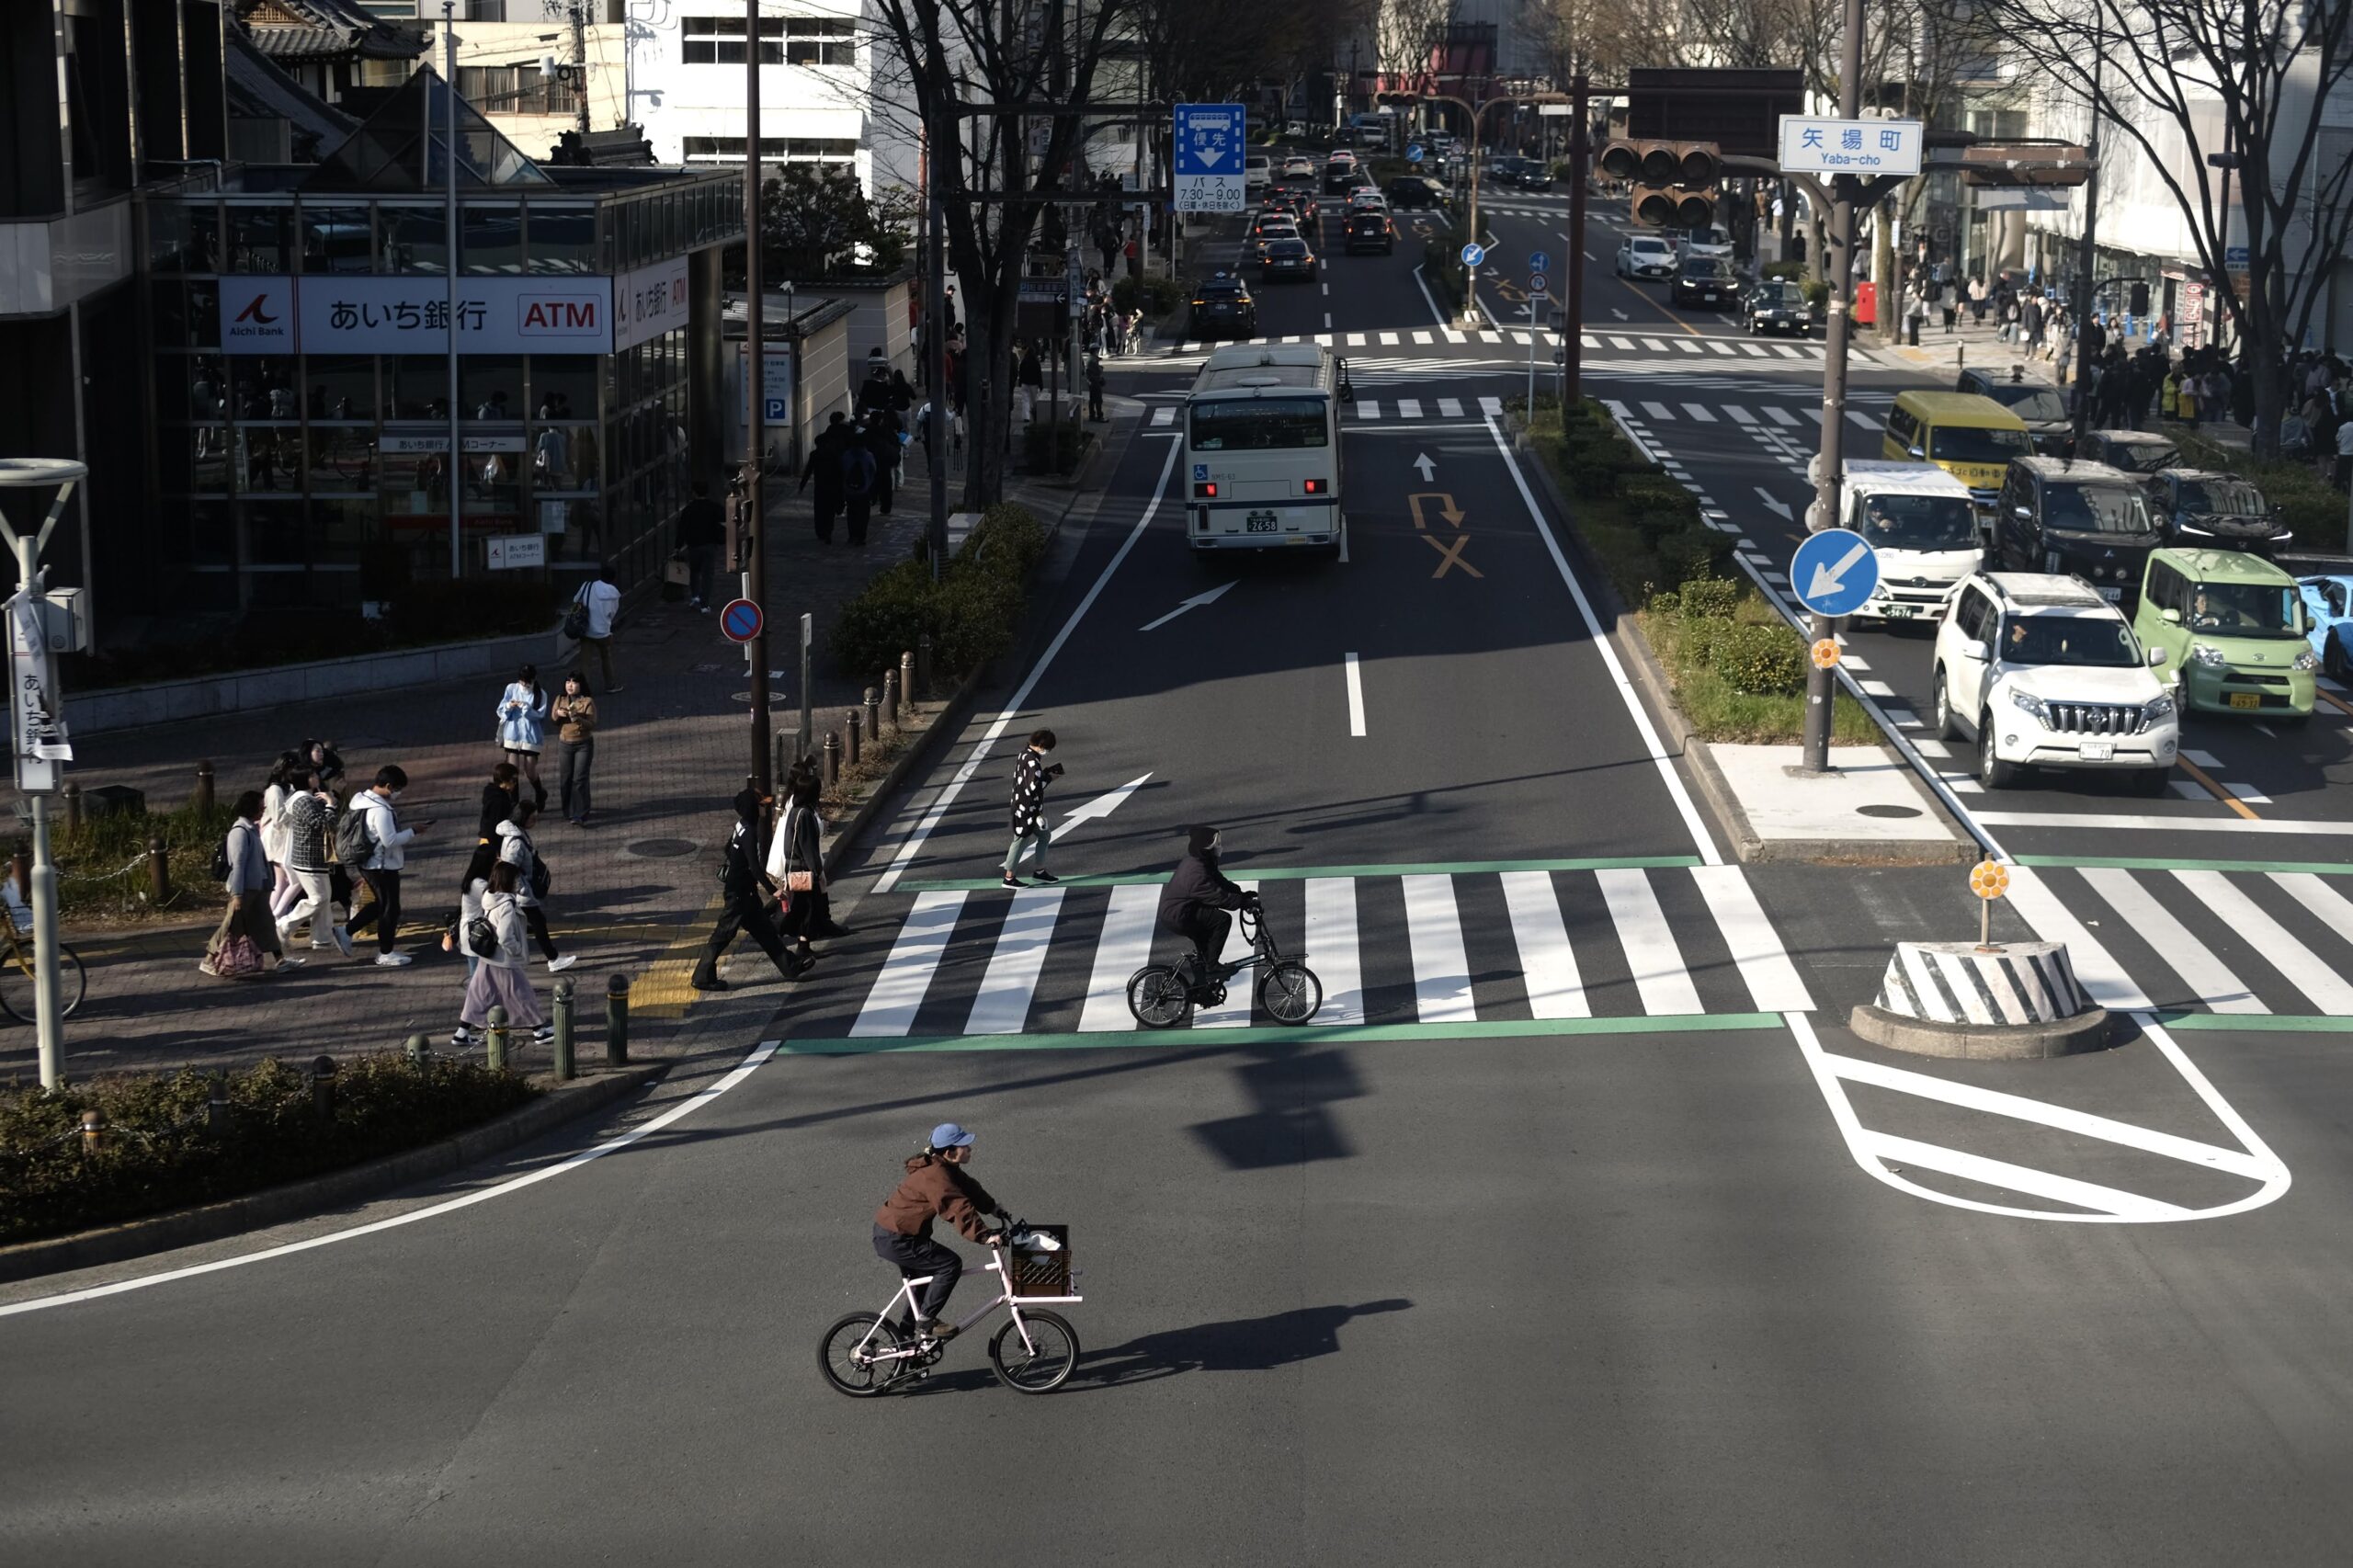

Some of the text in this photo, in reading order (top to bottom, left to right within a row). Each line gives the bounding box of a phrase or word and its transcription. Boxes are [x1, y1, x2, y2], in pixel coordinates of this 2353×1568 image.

[1193, 131, 1227, 147] 優先
[1802, 128, 1902, 152] 矢場町
[1821, 153, 1881, 165] Yaba-cho
[1193, 176, 1226, 187] バス
[672, 278, 687, 307] ATM
[330, 300, 487, 331] あいち銀行
[524, 302, 595, 328] ATM
[229, 326, 284, 336] Aichi Bank
[768, 401, 783, 417] P
[447, 440, 506, 449] AMコーナー
